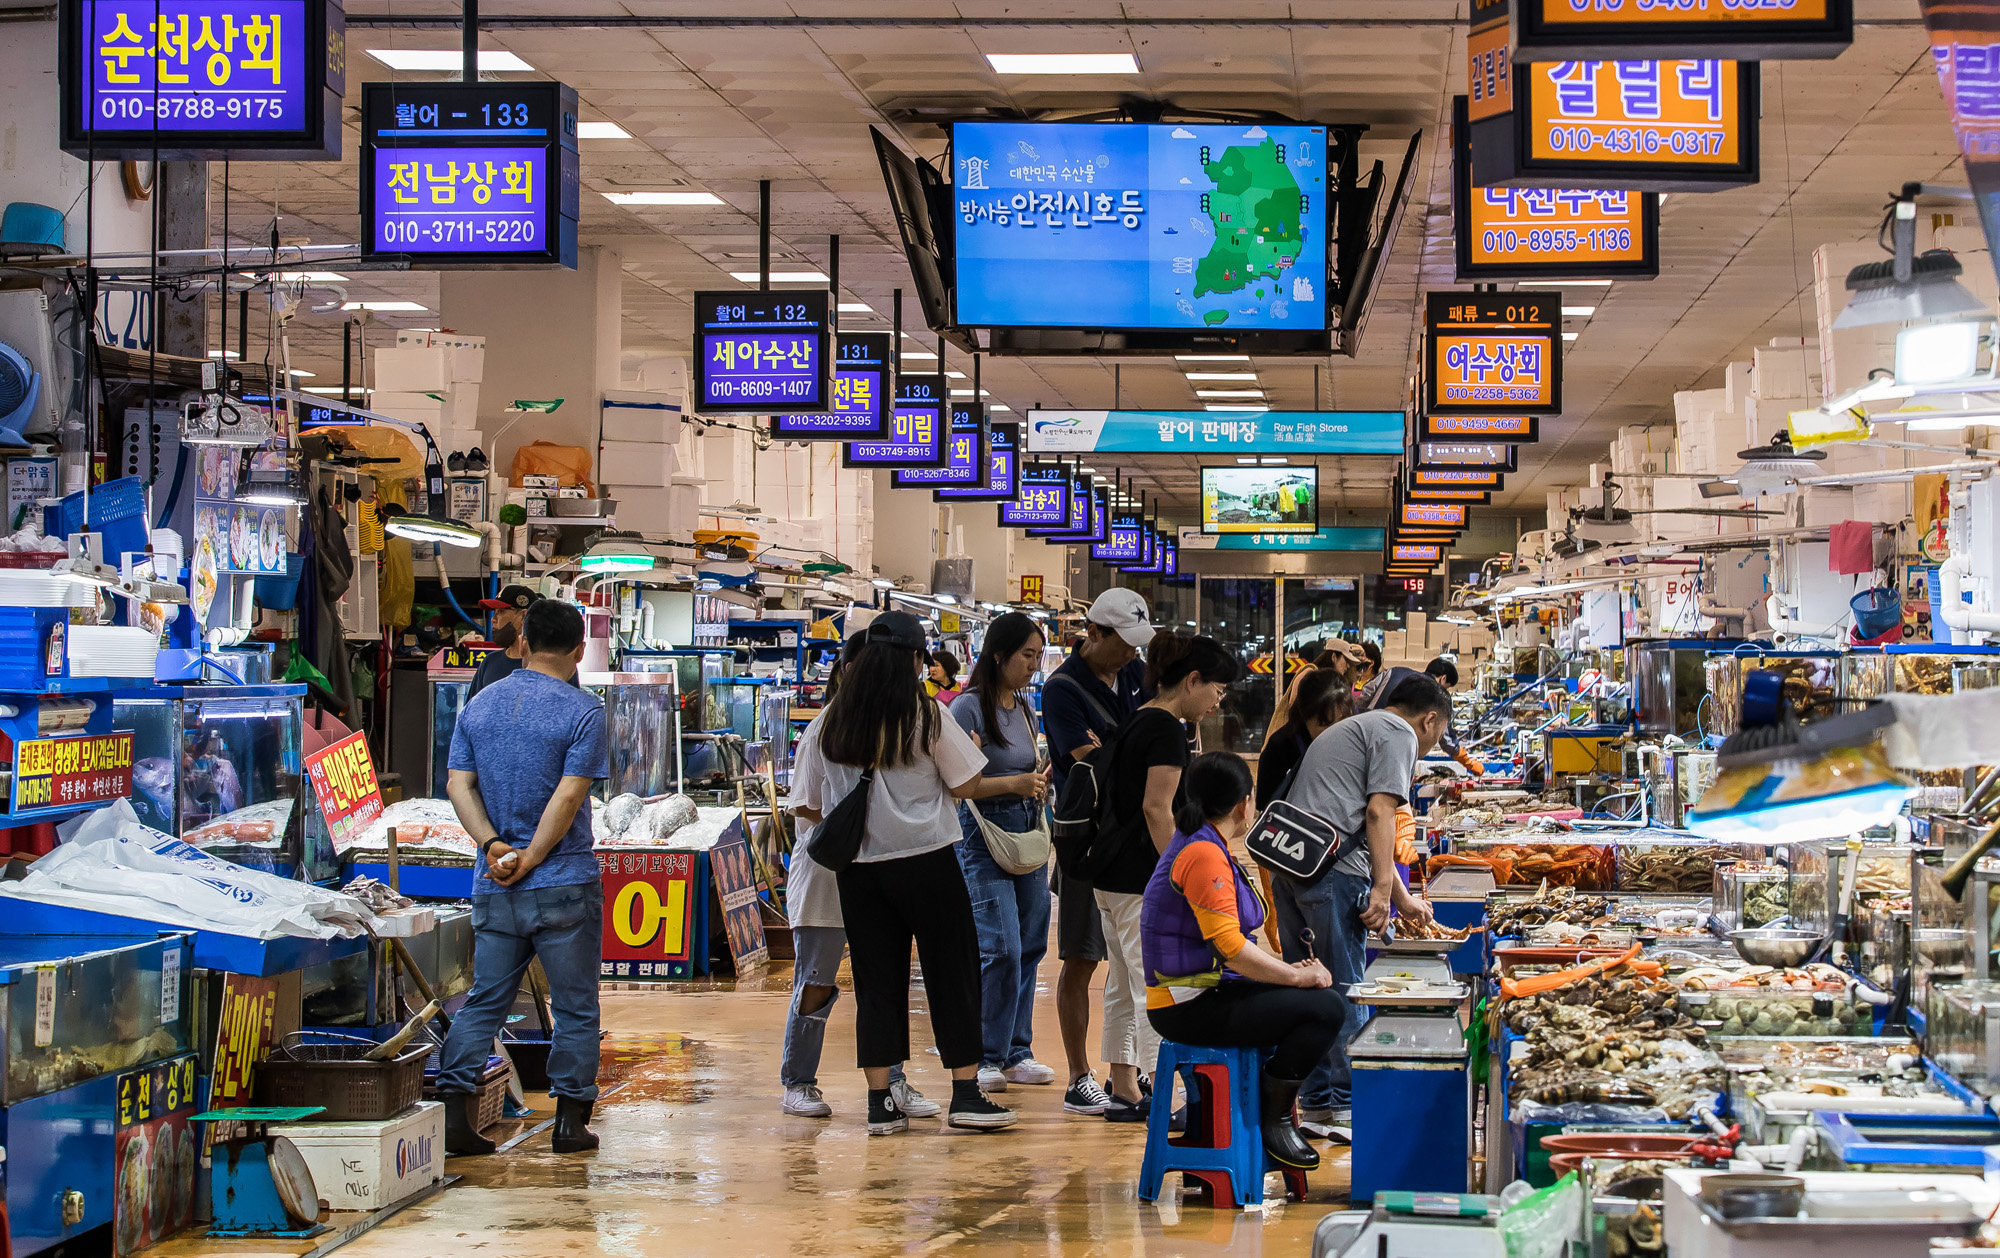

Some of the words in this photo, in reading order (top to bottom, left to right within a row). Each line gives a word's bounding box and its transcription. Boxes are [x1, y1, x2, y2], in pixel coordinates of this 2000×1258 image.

[100, 13, 281, 86] 순천상회
[1472, 44, 1509, 103] 갈릴리
[102, 98, 283, 119] 010-8788-9175
[395, 103, 439, 127] 활어
[481, 103, 529, 126] 133
[1549, 127, 1726, 155] 010-4316-0317
[387, 161, 533, 205] 전남상회
[1009, 165, 1058, 183] 대한민국
[1061, 163, 1096, 184] 수산물
[959, 199, 1012, 225] 방사능
[1011, 190, 1144, 229] 안전신호등
[384, 220, 535, 243] 010-3711-5220
[1483, 228, 1632, 253] 010-8955-1136
[716, 305, 746, 321] 활어
[774, 304, 807, 321] 132
[1448, 305, 1478, 322] 패류
[1506, 306, 1539, 322] 012
[713, 340, 812, 370] 세아수산
[842, 344, 868, 358] 131
[1446, 343, 1542, 384] 여수상회
[711, 381, 812, 397] 010-8609-1407
[904, 385, 930, 397] 130
[1446, 387, 1540, 400] 010-2258-5362
[788, 415, 871, 426] 010-3202-9395
[893, 414, 932, 443] 미림
[1273, 422, 1293, 432] Raw
[1296, 422, 1316, 432] Fish
[1319, 422, 1349, 433] Stores
[1437, 418, 1521, 430] 010-9459-4667
[1158, 421, 1194, 442] 활어
[1201, 421, 1258, 443] 판매장
[859, 447, 931, 456] 010-3749-8915
[951, 439, 970, 463] 회
[904, 469, 970, 478] 010-5267-8346
[1041, 469, 1060, 478] 127
[1009, 512, 1060, 521] 010-7123-9700
[54, 741, 80, 775] 정성껏
[81, 736, 132, 772] 모시겠습니다.
[322, 738, 377, 812] 민어전문
[1258, 825, 1305, 861] FILA
[596, 854, 619, 874] 름철
[623, 854, 648, 875] 인기
[650, 854, 689, 875] 보양식
[612, 880, 687, 955] 어
[600, 962, 631, 976] 분할
[638, 962, 669, 976] 판매
[167, 1060, 194, 1111] 상회
